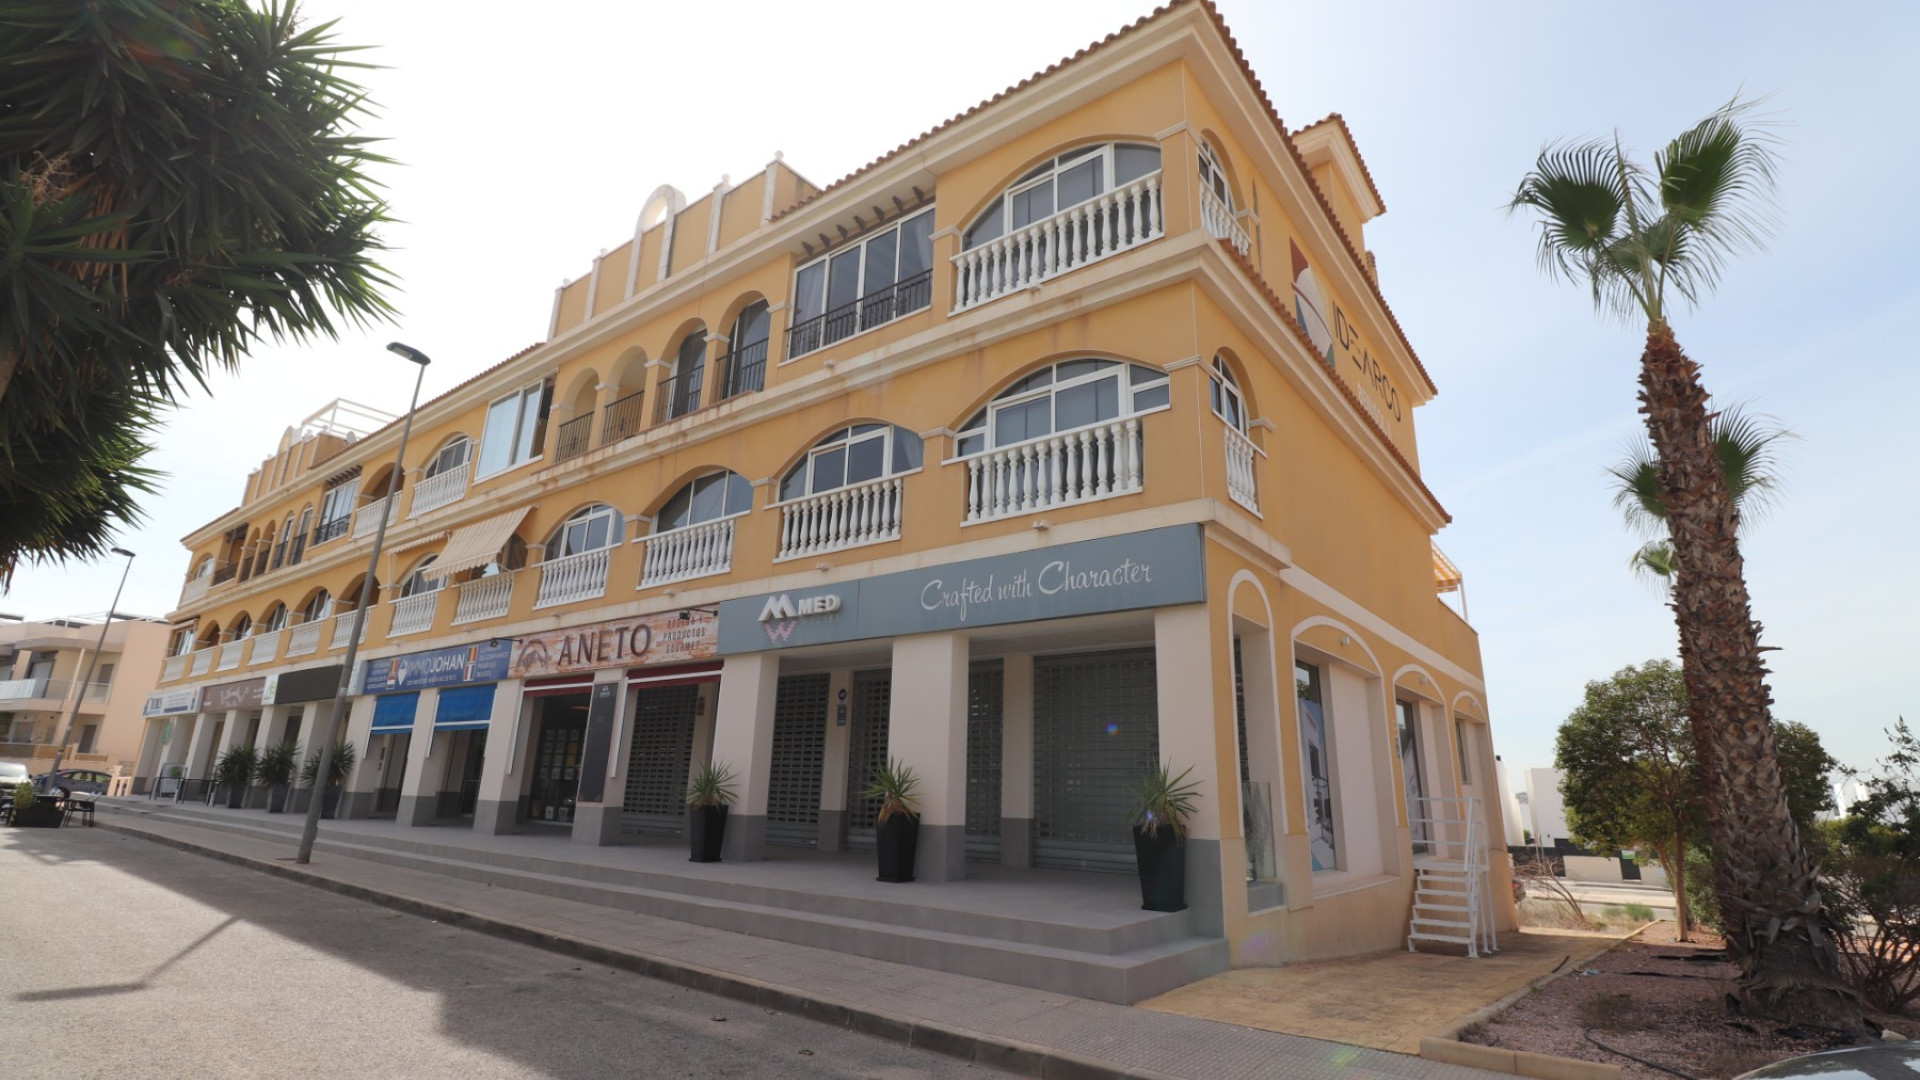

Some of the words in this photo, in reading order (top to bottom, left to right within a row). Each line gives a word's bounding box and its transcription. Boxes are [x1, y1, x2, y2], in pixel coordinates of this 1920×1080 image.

[920, 574, 994, 622] Crafted
[998, 569, 1034, 600] with
[1038, 557, 1153, 595] Character
[798, 594, 841, 615] MED
[663, 627, 706, 641] PRODUCTOS
[557, 623, 652, 667] ANETO
[666, 640, 701, 654] GOURMET
